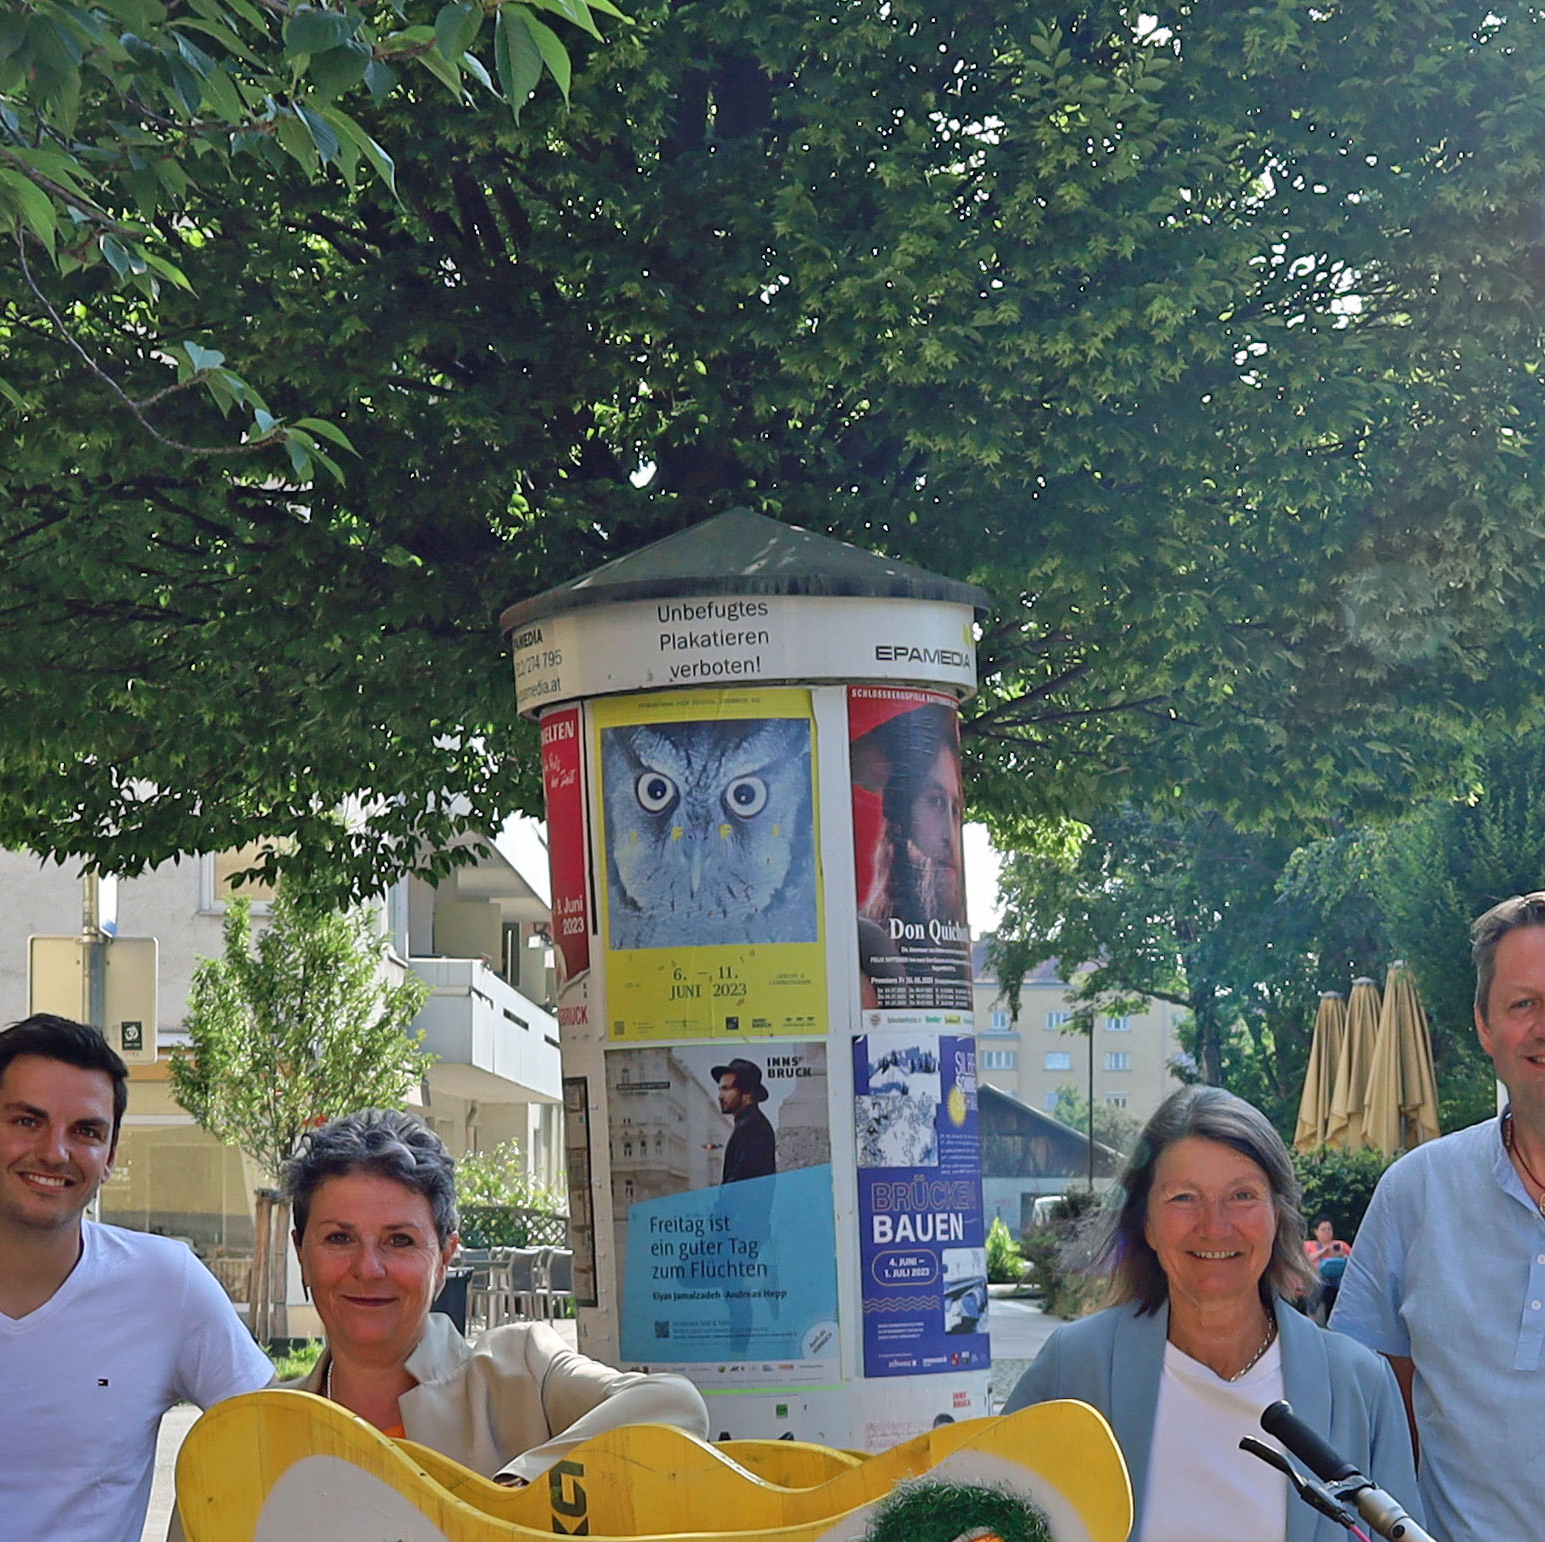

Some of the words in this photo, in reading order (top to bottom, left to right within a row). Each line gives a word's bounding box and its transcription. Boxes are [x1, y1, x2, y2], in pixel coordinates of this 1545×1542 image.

[657, 601, 769, 623] Unbefugtes
[660, 629, 769, 652] Plakatieren
[670, 656, 762, 679] verboten!
[875, 645, 971, 668] EPAMEDIA
[563, 917, 585, 935] 2023
[888, 918, 926, 940] Don
[673, 967, 687, 982] 6.
[718, 966, 739, 980] 11.
[668, 983, 703, 1001] JUNI
[712, 982, 748, 998] 2023
[767, 1067, 813, 1079] BRUCK
[650, 1215, 705, 1236] Freitag
[709, 1214, 731, 1233] ist
[873, 1212, 964, 1244] BAUEN
[651, 1241, 674, 1257] ein
[679, 1238, 723, 1261] guter
[728, 1237, 759, 1259] Tag
[652, 1264, 686, 1280] zum
[691, 1259, 768, 1279] Flüchten
[911, 1267, 930, 1277] 2023
[725, 1290, 762, 1300] Andreas
[763, 1289, 788, 1300] Hepp
